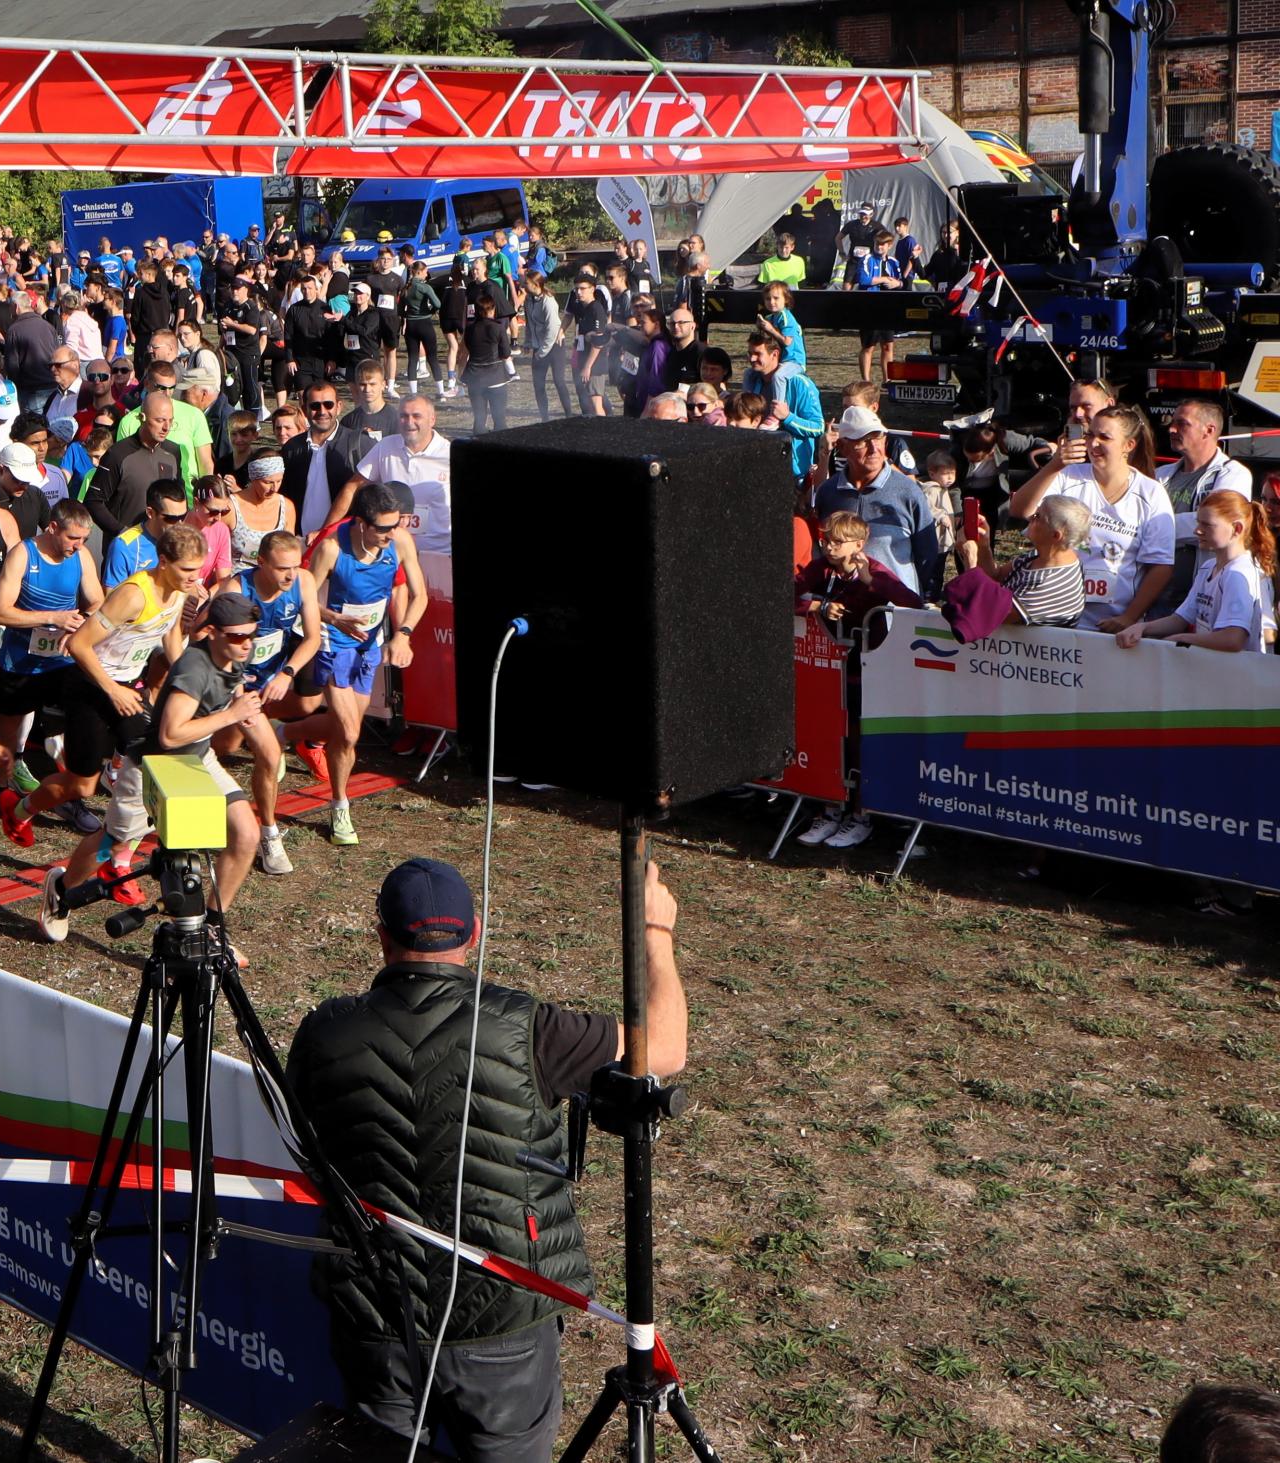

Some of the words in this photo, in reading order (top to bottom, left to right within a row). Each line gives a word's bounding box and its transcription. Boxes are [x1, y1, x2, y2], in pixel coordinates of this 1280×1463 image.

[73, 203, 117, 212] Technisches
[84, 211, 118, 219] Hilfswerk
[1080, 335, 1118, 348] 24/46
[897, 386, 916, 400] THW
[922, 386, 953, 401] 89591
[970, 637, 1083, 665] STADTWERKE
[970, 658, 1084, 689] SCHÖNEBECK
[919, 758, 978, 789] Mehr
[984, 771, 1089, 814] Leistung
[1095, 793, 1138, 819] mit
[1145, 803, 1250, 838] unserer
[918, 791, 992, 819] #regional
[995, 805, 1049, 830] #stark
[1053, 816, 1143, 846] #teamsws
[14, 1217, 54, 1259] mit
